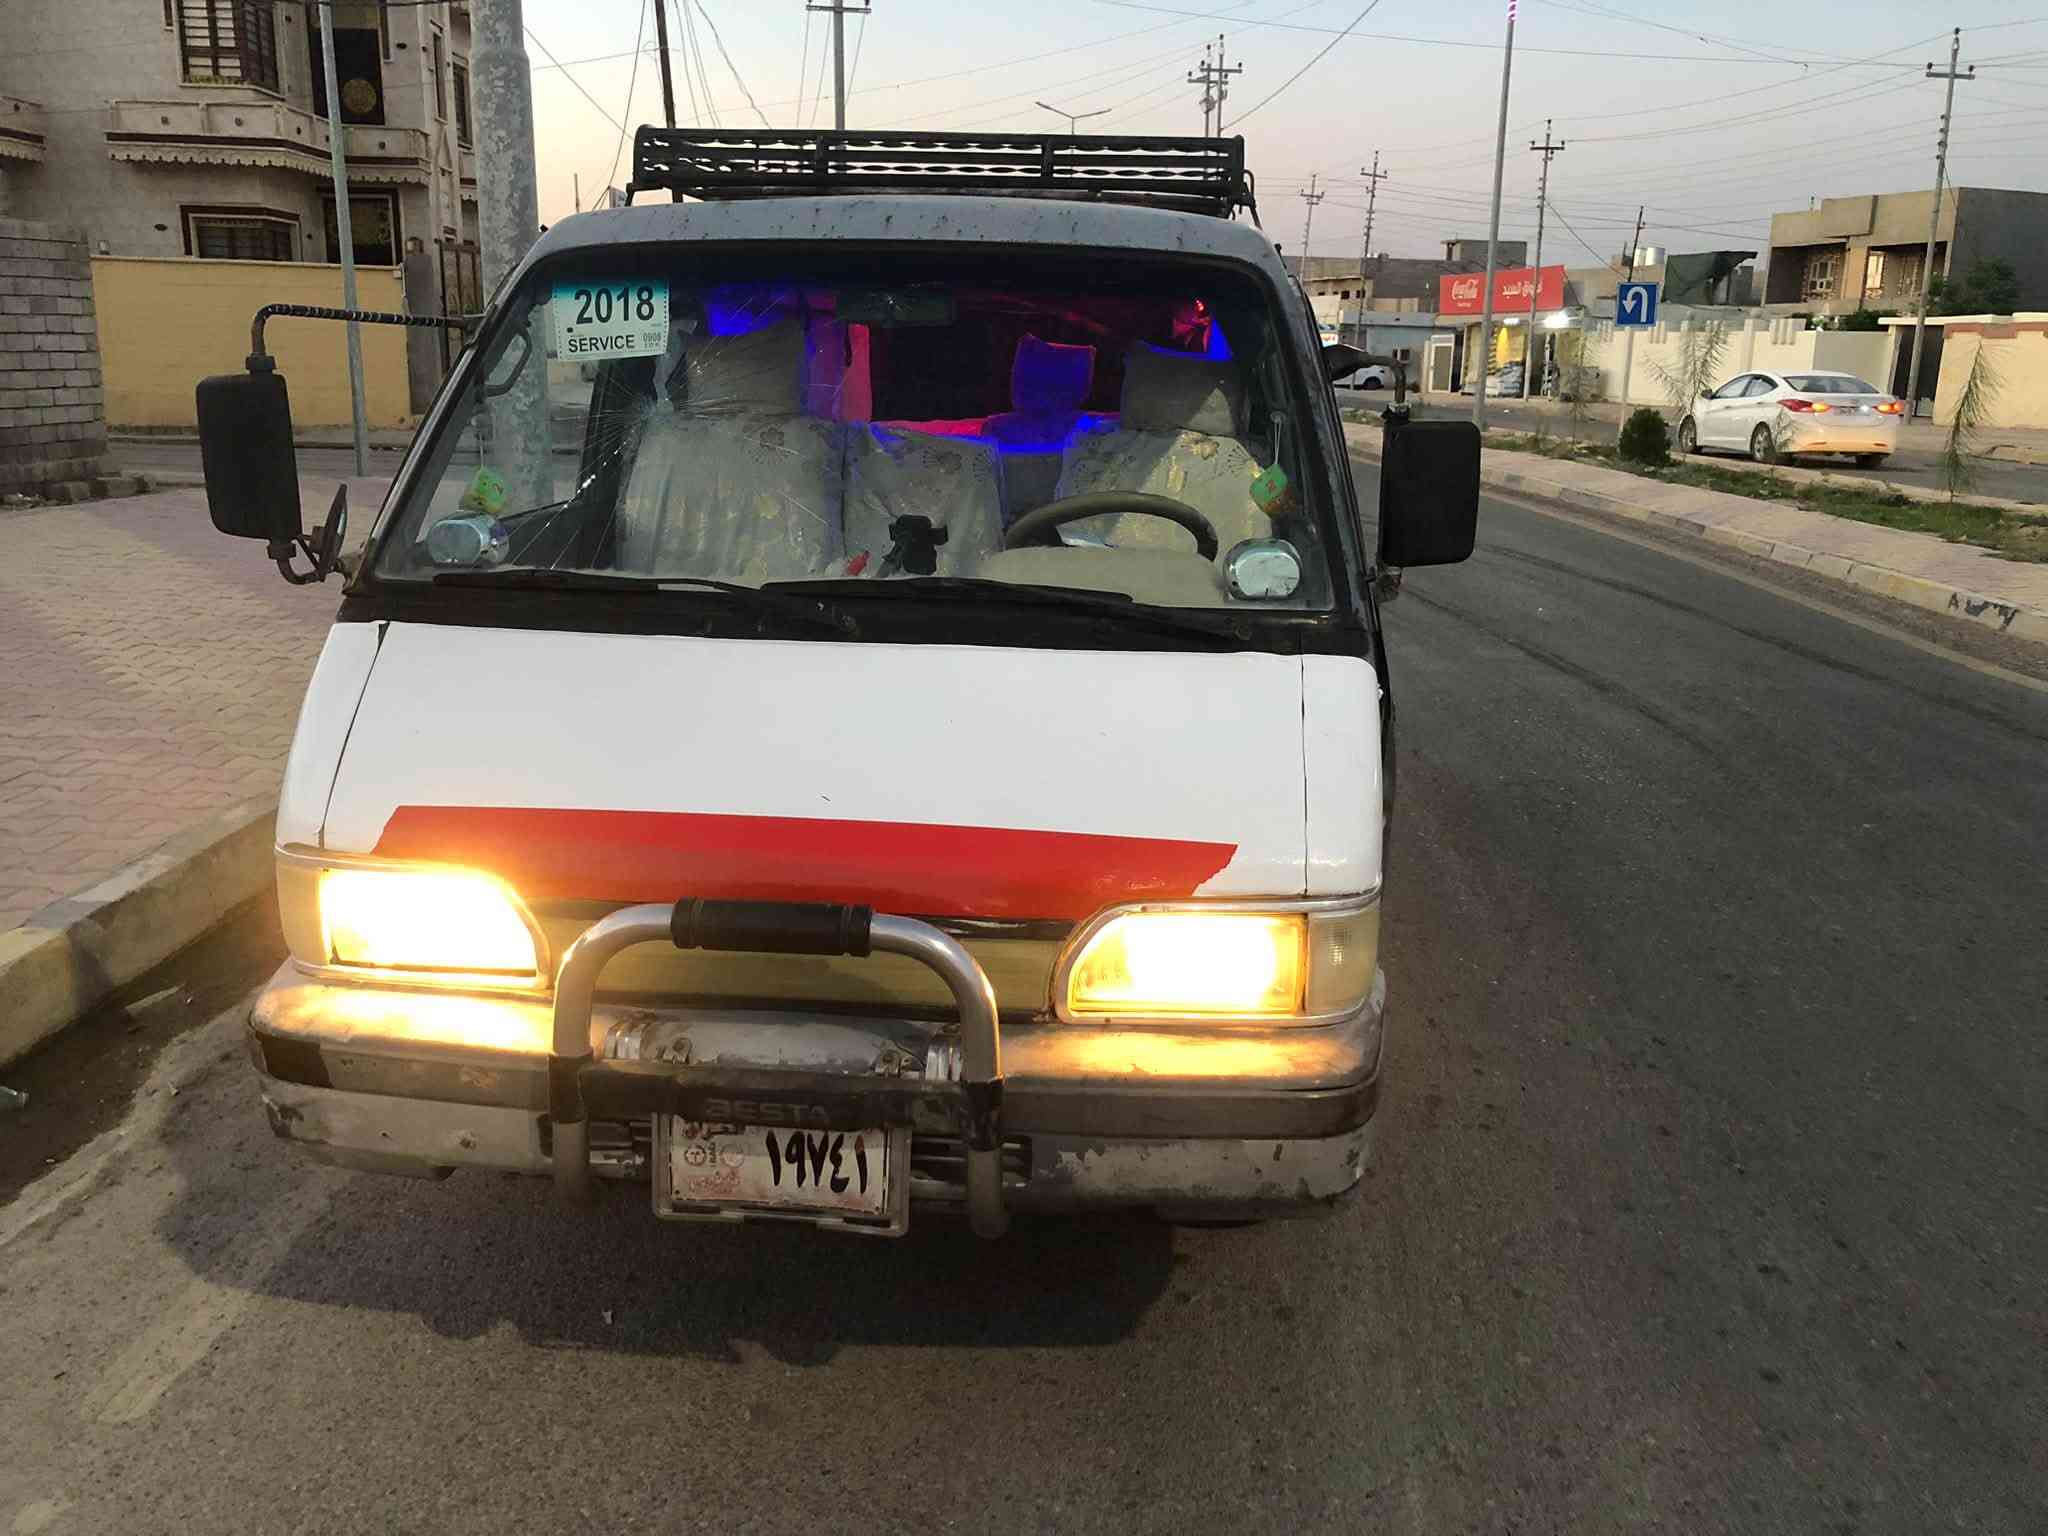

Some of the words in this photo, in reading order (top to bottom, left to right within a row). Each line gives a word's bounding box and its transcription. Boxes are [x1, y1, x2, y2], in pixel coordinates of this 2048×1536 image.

[574, 286, 655, 325] 2018
[568, 334, 635, 353] SERVICE
[765, 1129, 869, 1195] ١٩٧٤١
